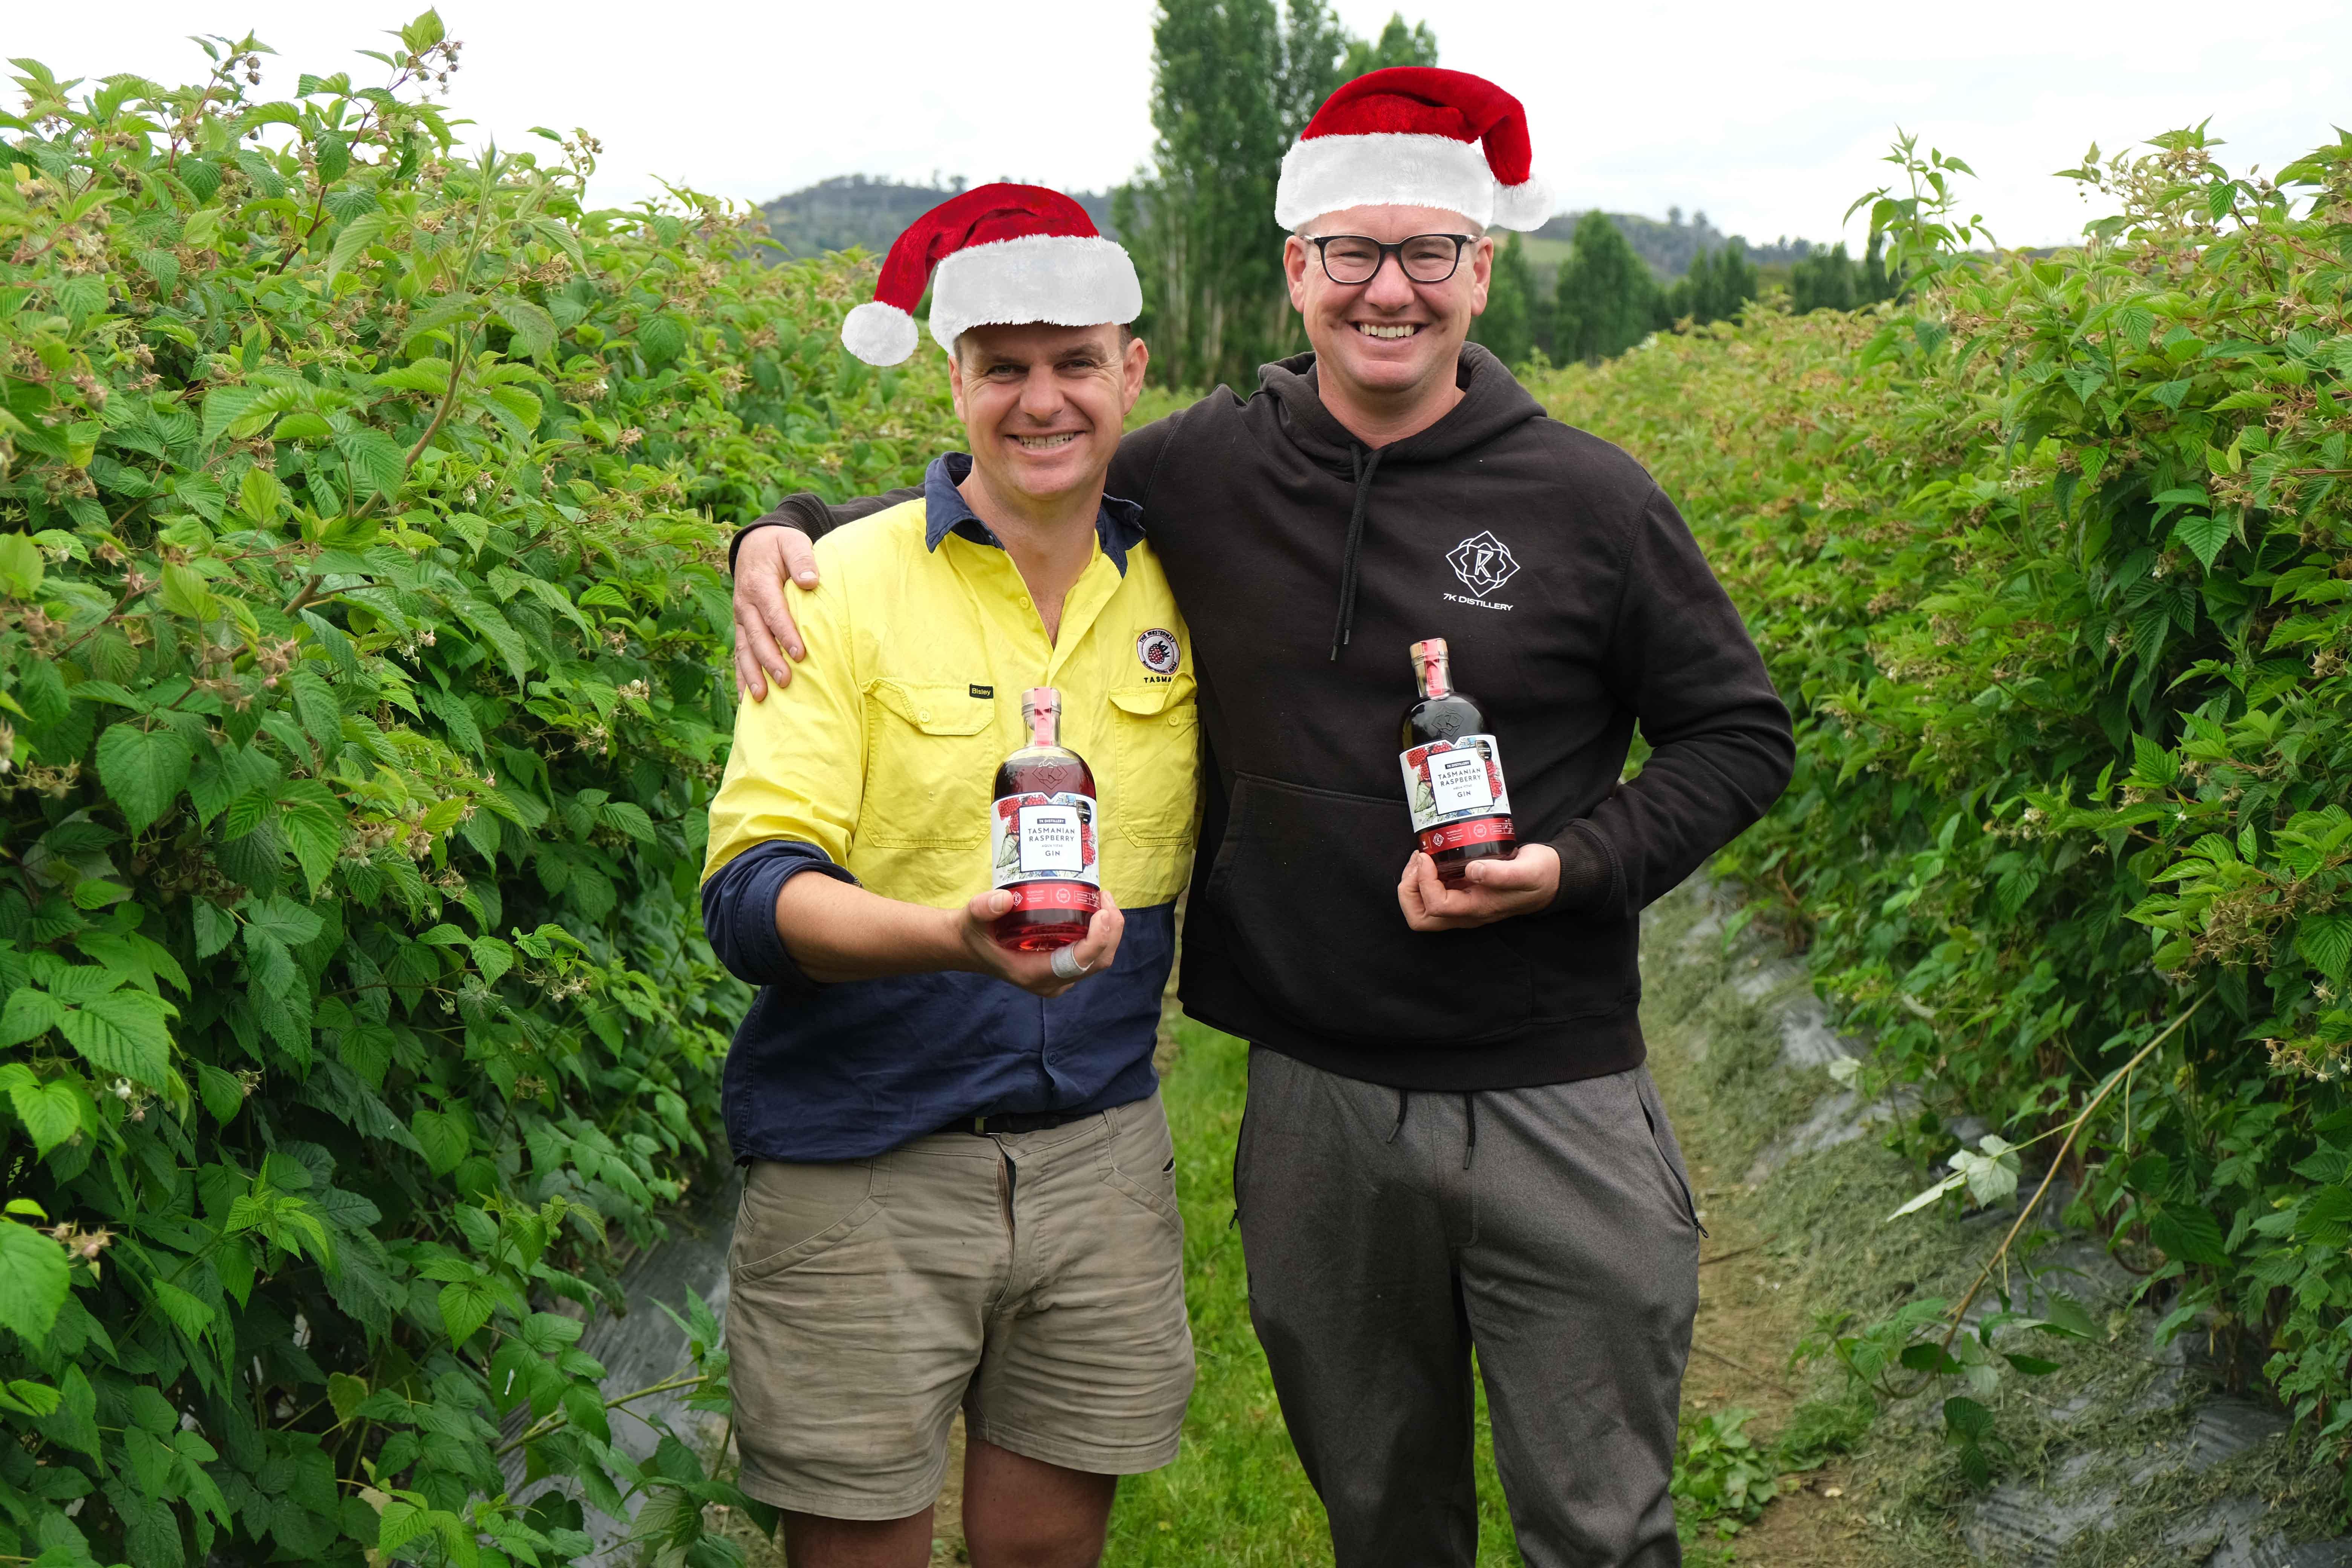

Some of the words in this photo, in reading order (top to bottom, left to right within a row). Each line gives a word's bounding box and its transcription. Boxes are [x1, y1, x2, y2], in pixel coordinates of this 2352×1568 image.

[1443, 593, 1457, 601] 7K
[1458, 596, 1513, 611] DISTILLERY
[1147, 630, 1175, 643] WESTERWAY
[1438, 768, 1481, 780] TASMANIAN
[1440, 775, 1481, 787] RASPBERRY
